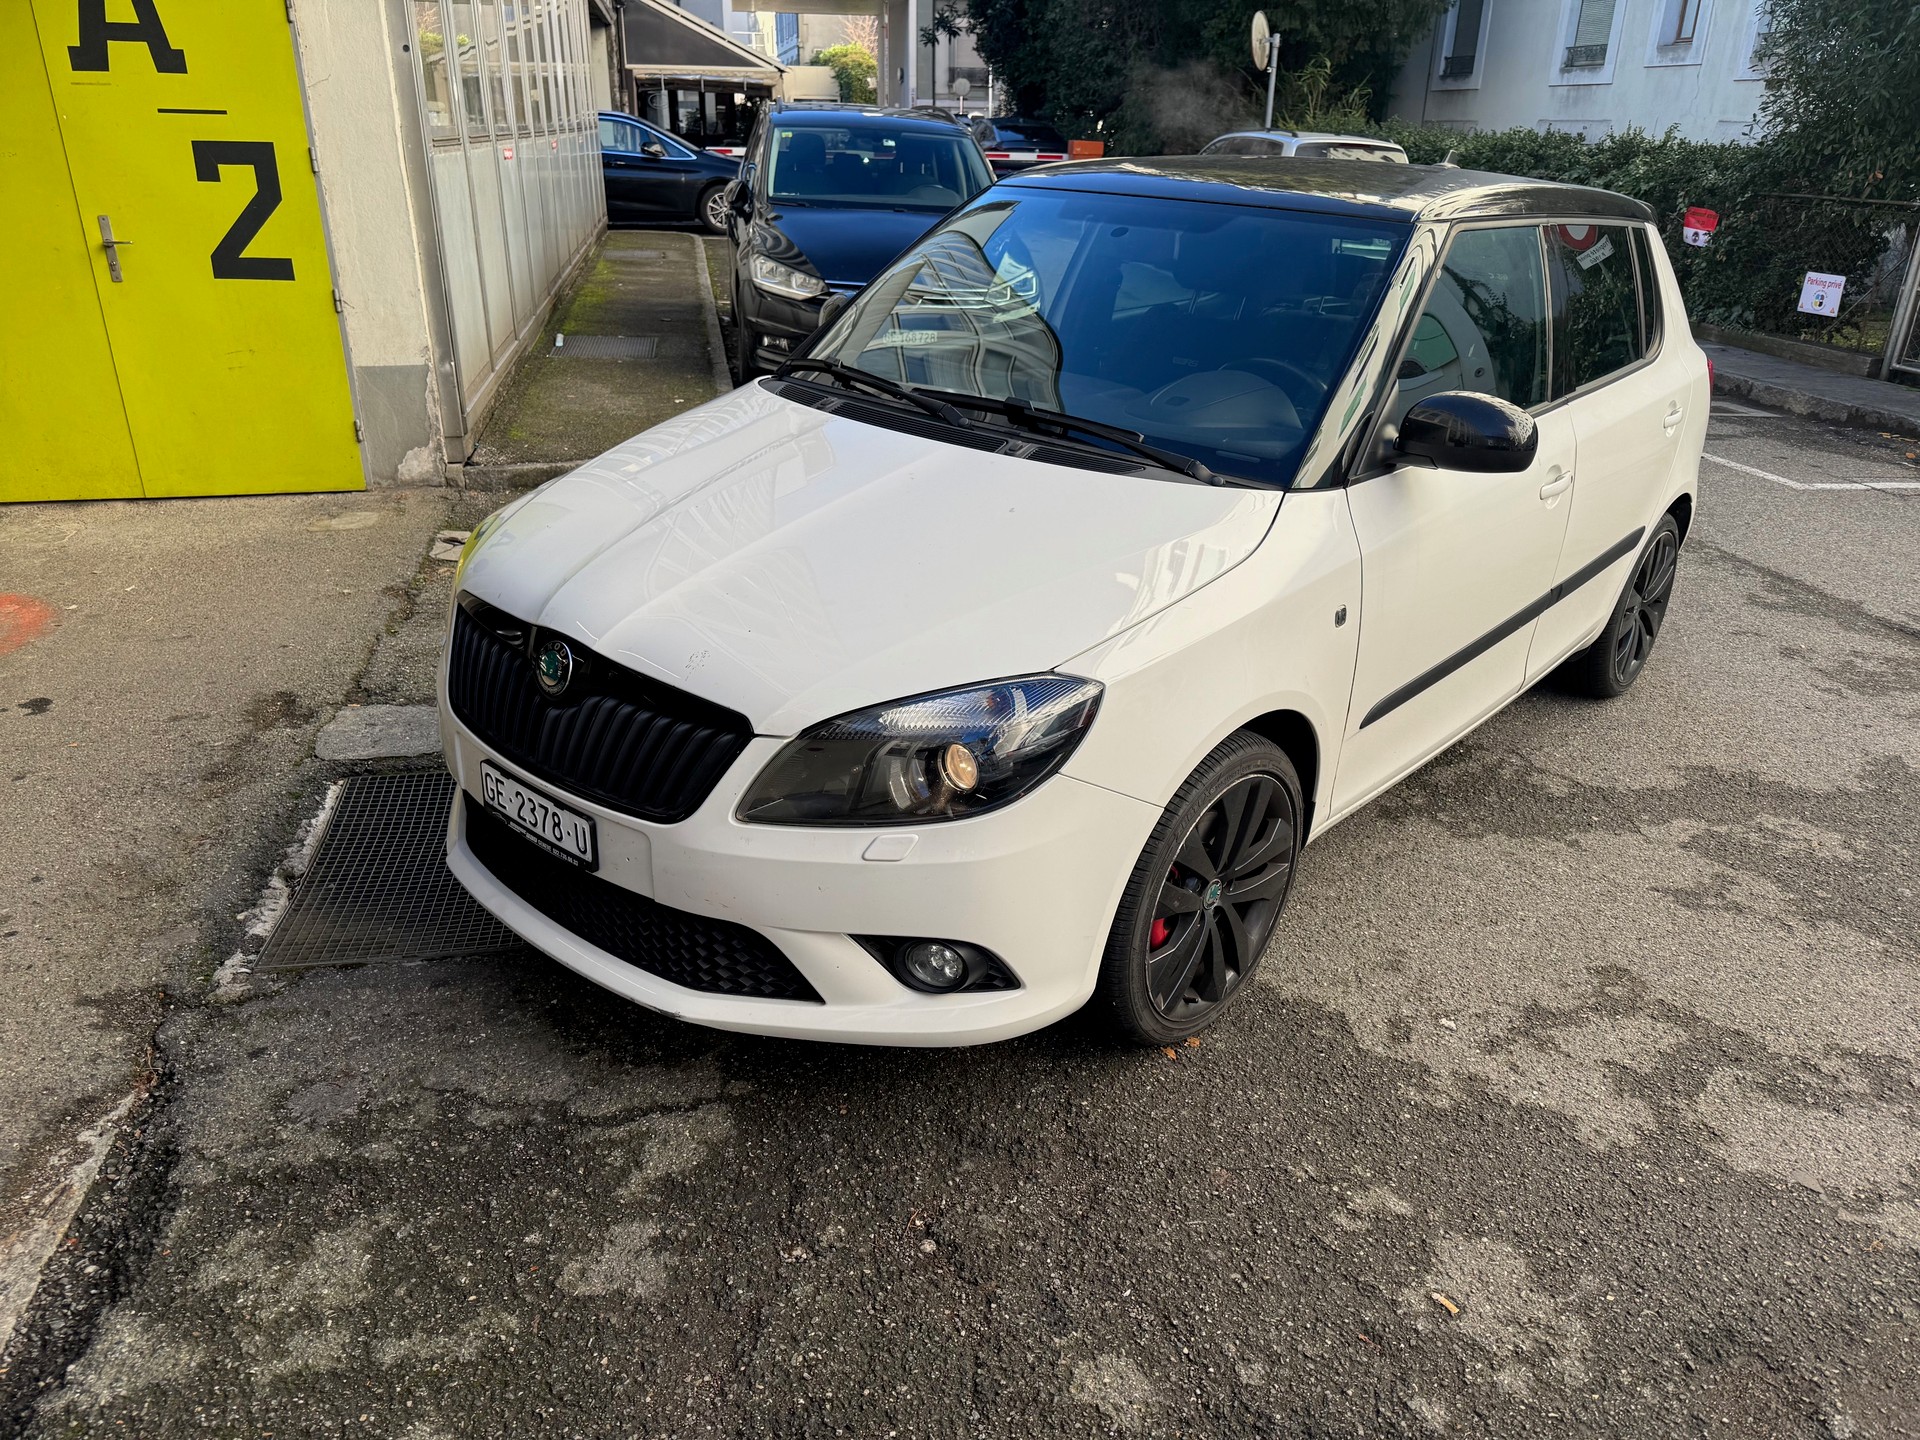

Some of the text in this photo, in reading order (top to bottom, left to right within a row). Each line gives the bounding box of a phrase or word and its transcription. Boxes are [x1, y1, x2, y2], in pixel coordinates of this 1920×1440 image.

[67, 0, 188, 74] A
[191, 140, 296, 281] 2
[1807, 276, 1843, 289] Parking privé
